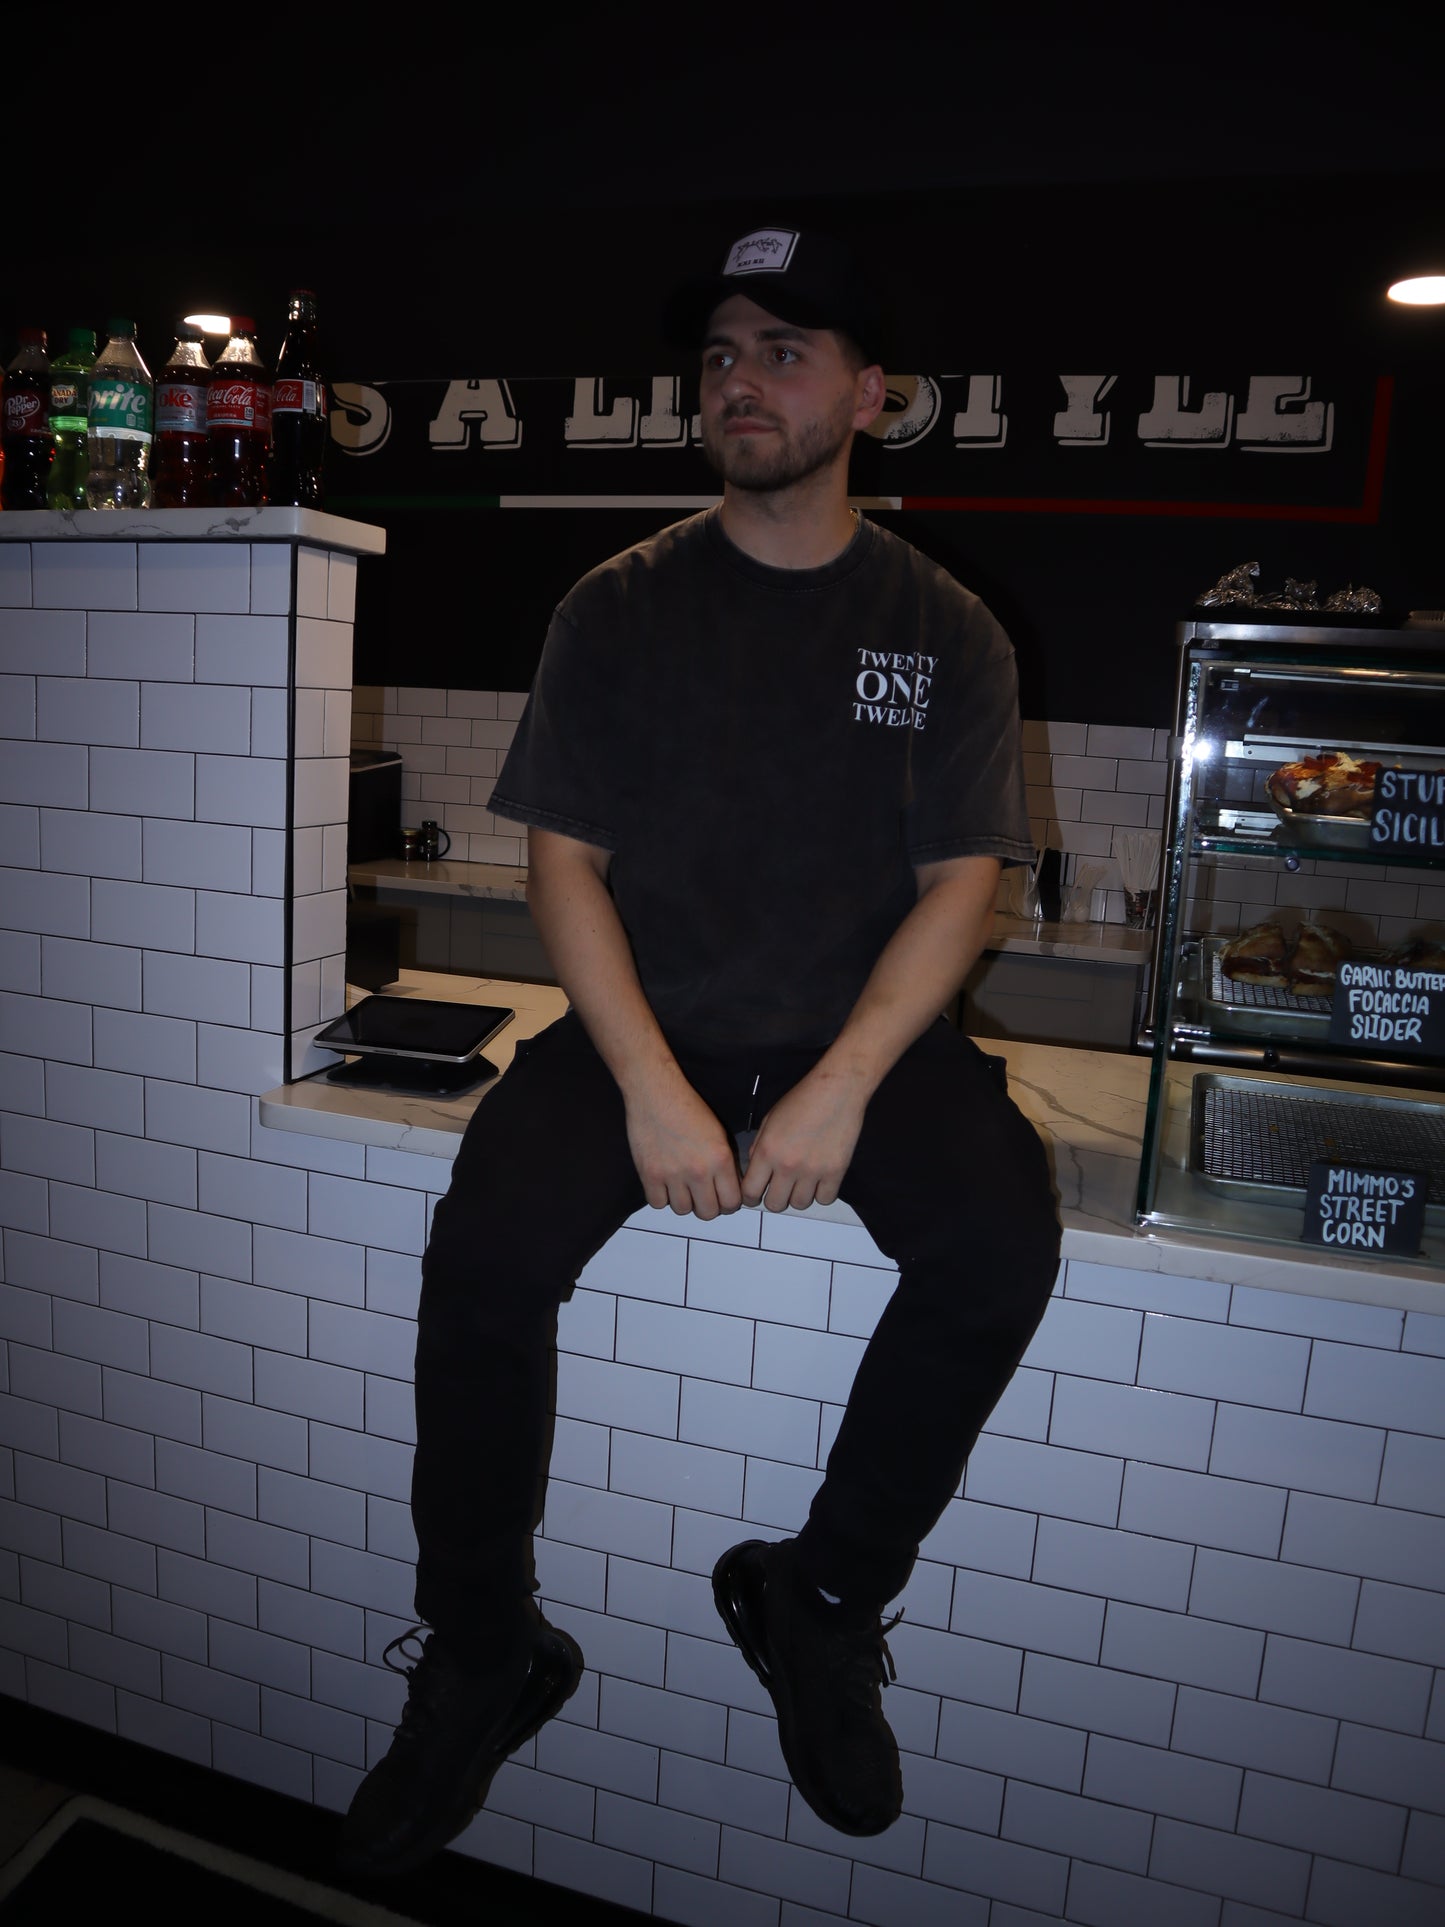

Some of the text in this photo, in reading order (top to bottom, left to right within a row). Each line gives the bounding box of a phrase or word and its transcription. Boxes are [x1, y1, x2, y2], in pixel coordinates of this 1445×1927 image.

[6, 398, 38, 416] Pepper
[15, 395, 28, 405] Dr
[87, 384, 146, 416] prite
[159, 388, 192, 408] oke
[857, 647, 939, 673] TWENTY
[856, 669, 932, 709] ONE
[1372, 809, 1445, 846] SICIL
[1348, 989, 1430, 1015] FOCACCIA
[1350, 1013, 1423, 1043] SLIDER
[1327, 1169, 1415, 1198] MIMMO'S
[1319, 1193, 1405, 1225] STREET
[1322, 1219, 1386, 1248] CORN
